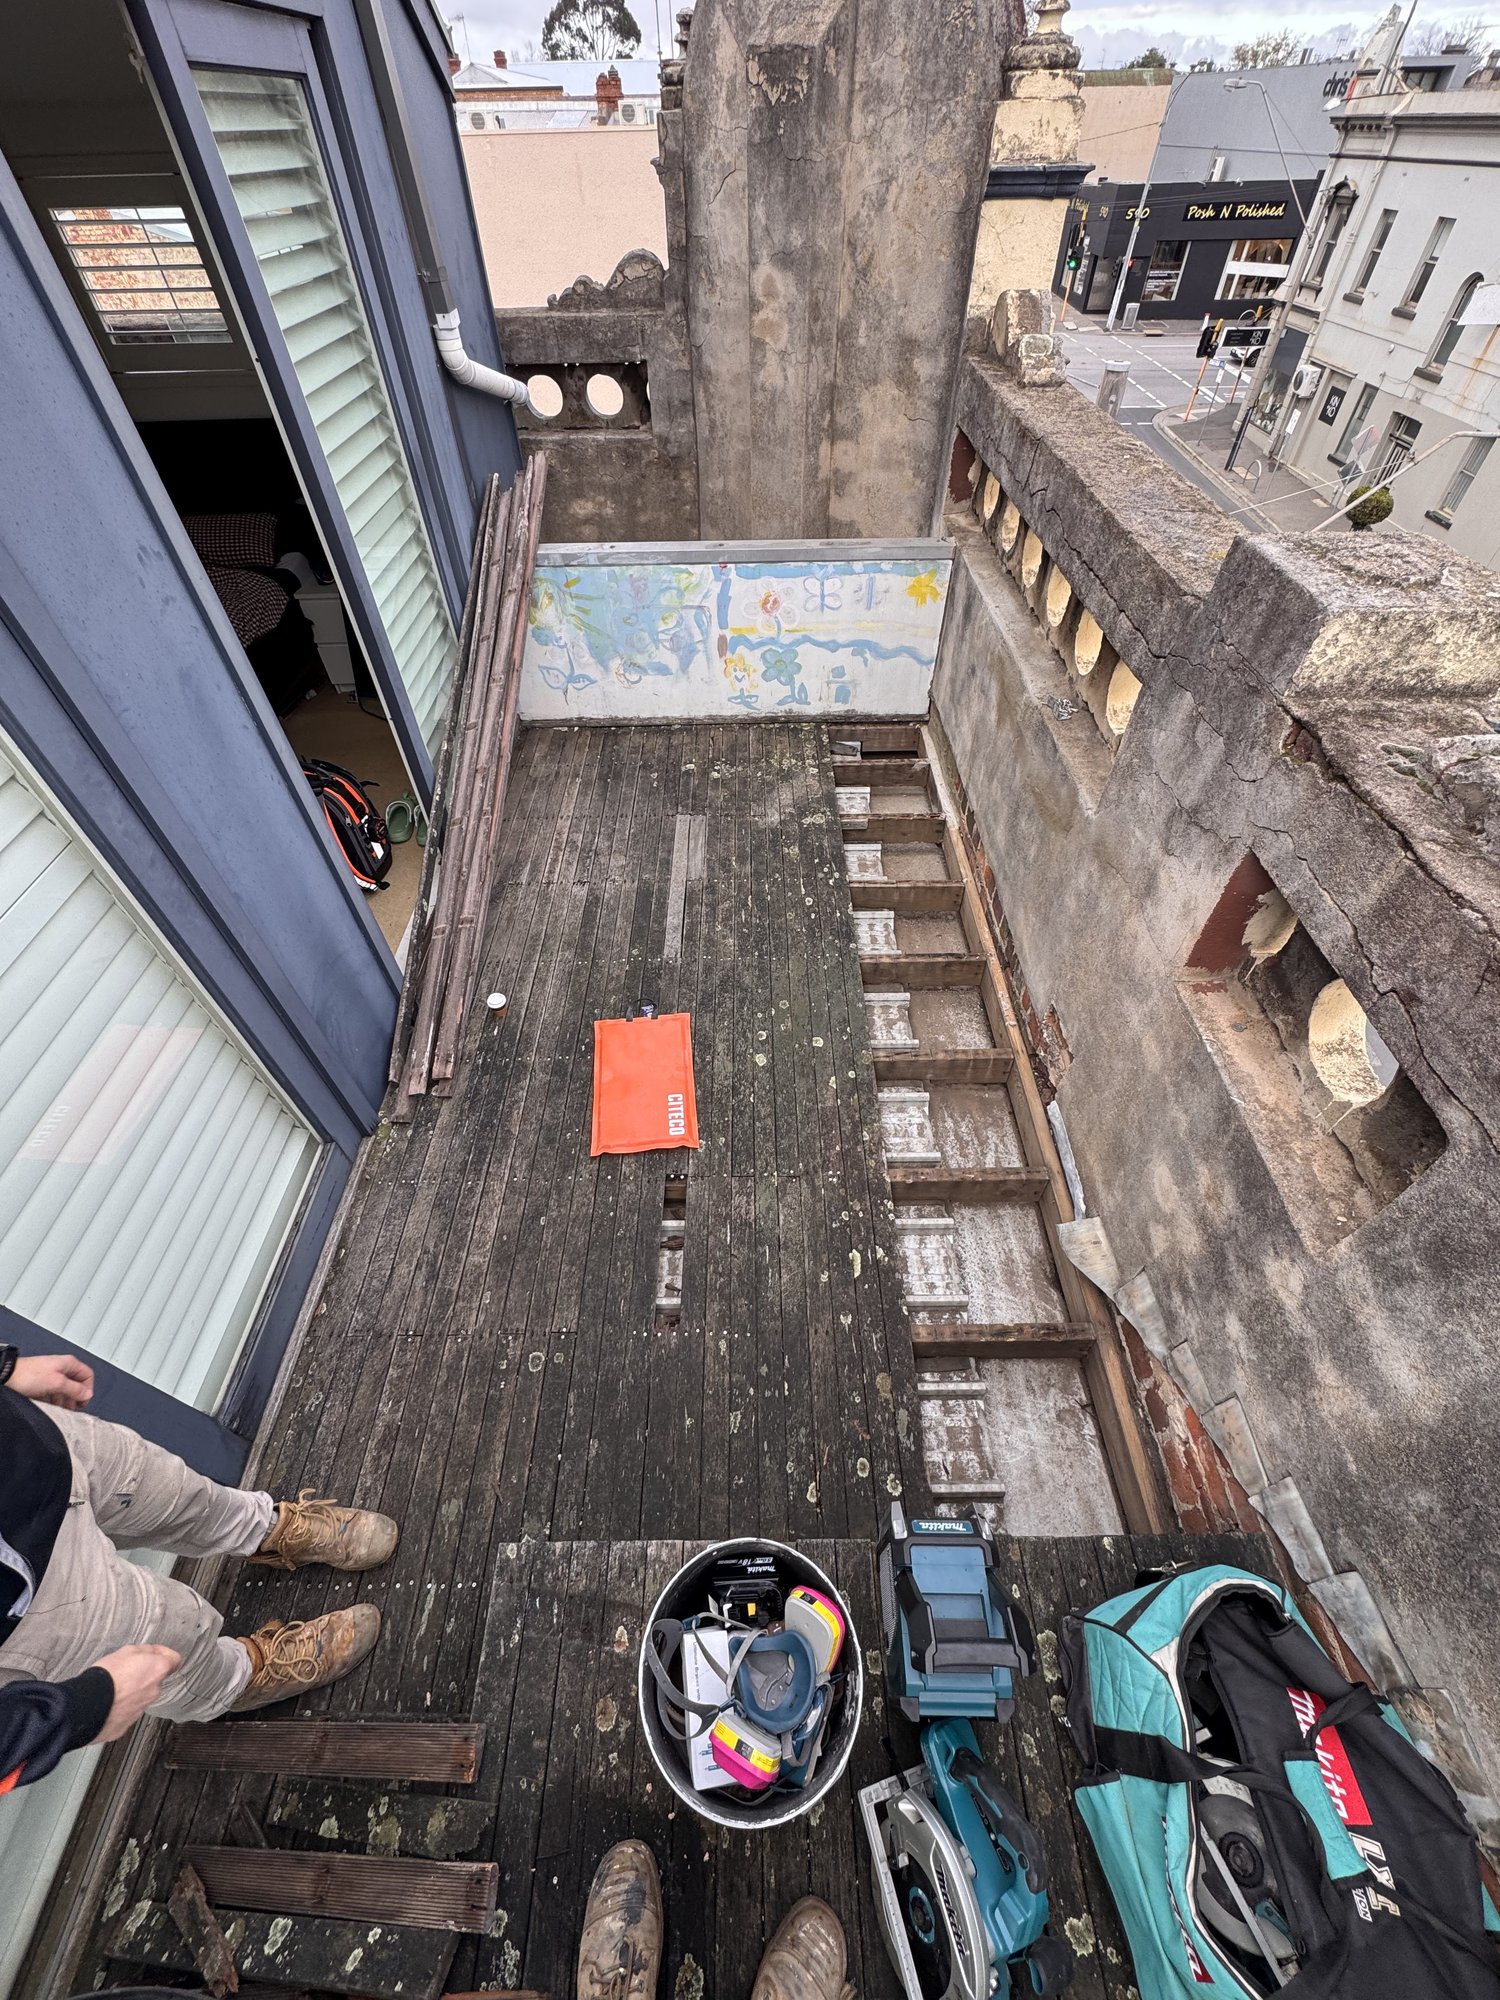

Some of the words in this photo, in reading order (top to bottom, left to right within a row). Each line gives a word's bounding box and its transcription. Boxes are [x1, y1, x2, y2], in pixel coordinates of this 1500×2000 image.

[1187, 204, 1215, 219] Posh
[1219, 204, 1233, 218] N
[1235, 203, 1285, 217] Polished
[668, 1093, 685, 1136] CITECO
[918, 1522, 967, 1532] makita
[746, 1565, 776, 1574] makita
[934, 1863, 970, 1960] makita
